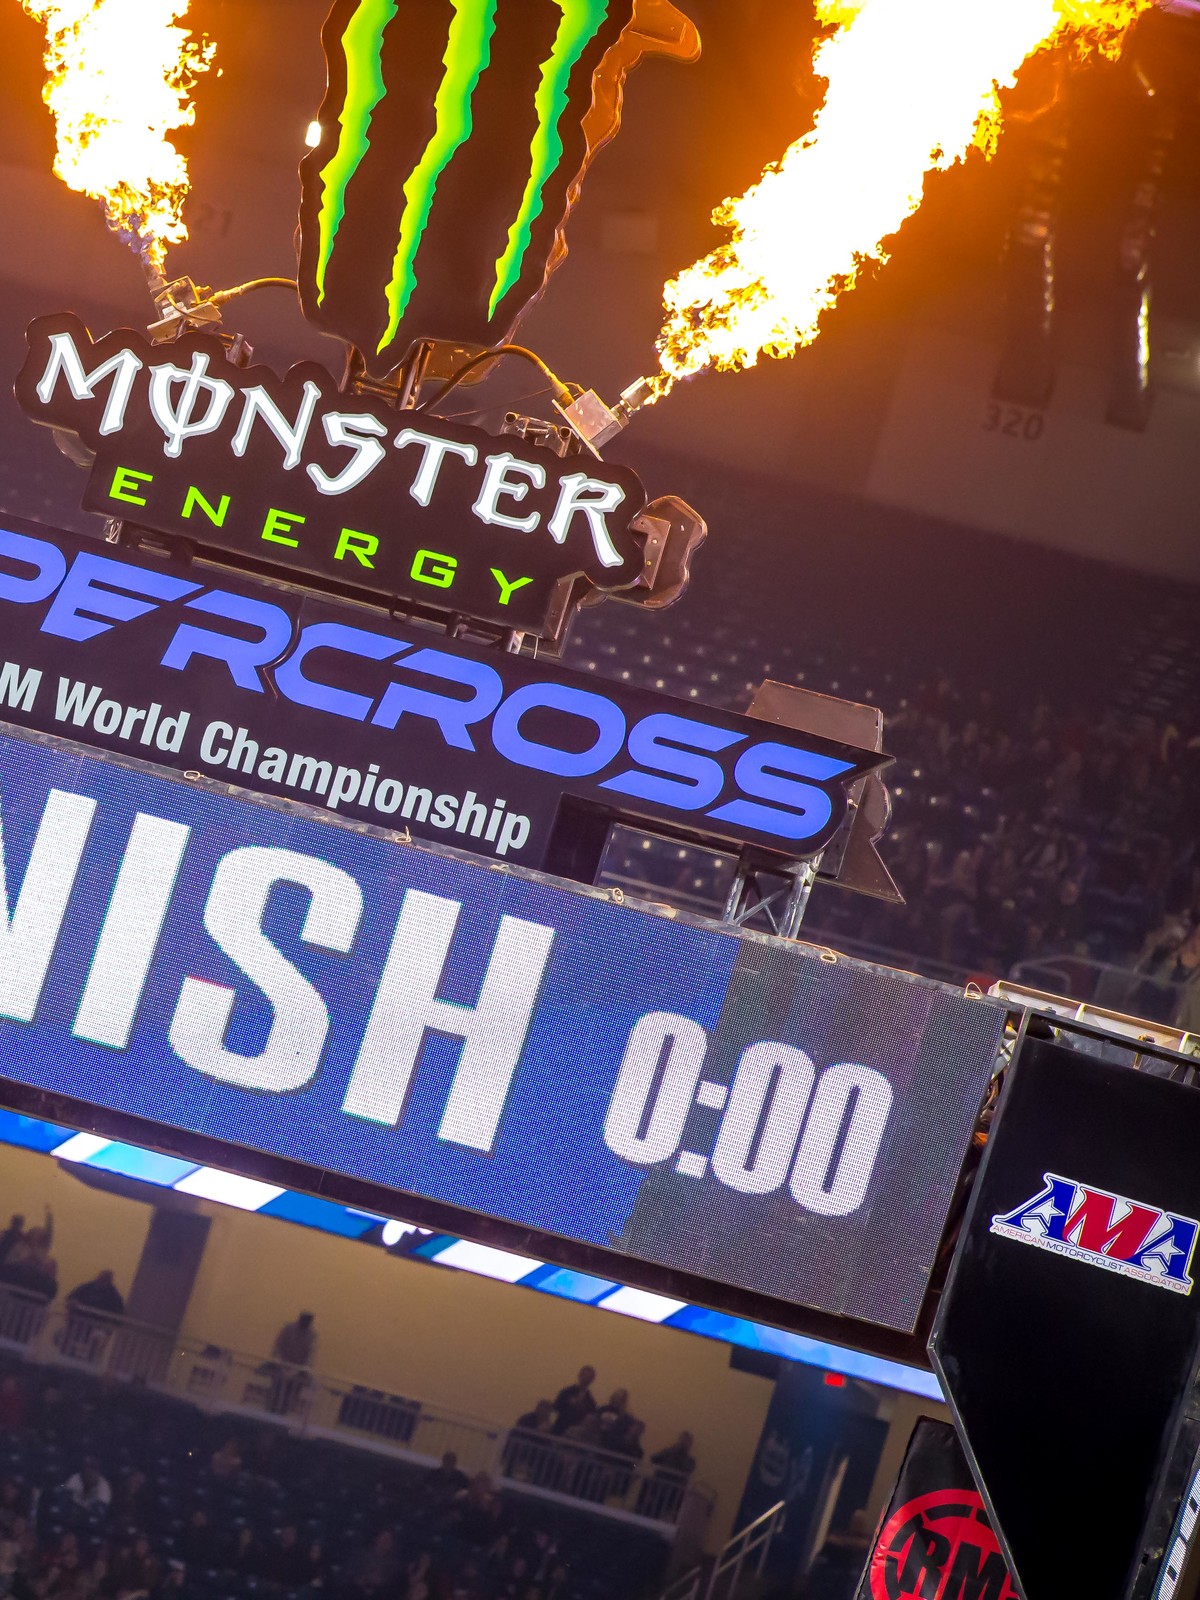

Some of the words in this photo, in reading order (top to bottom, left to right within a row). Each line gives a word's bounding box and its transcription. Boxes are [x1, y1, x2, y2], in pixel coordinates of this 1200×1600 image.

[38, 332, 626, 568] MONSTER
[980, 402, 1043, 441] 320
[108, 466, 534, 605] ENERGY
[54, 676, 191, 753] World
[200, 721, 531, 856] Championship
[603, 1010, 894, 1217] 0:00
[993, 1224, 1047, 1248] AMERICAN
[1046, 1242, 1125, 1271] MOTORCYCLIST
[1124, 1266, 1191, 1293] ASSOCIATION
[995, 1175, 1198, 1284] AMA
